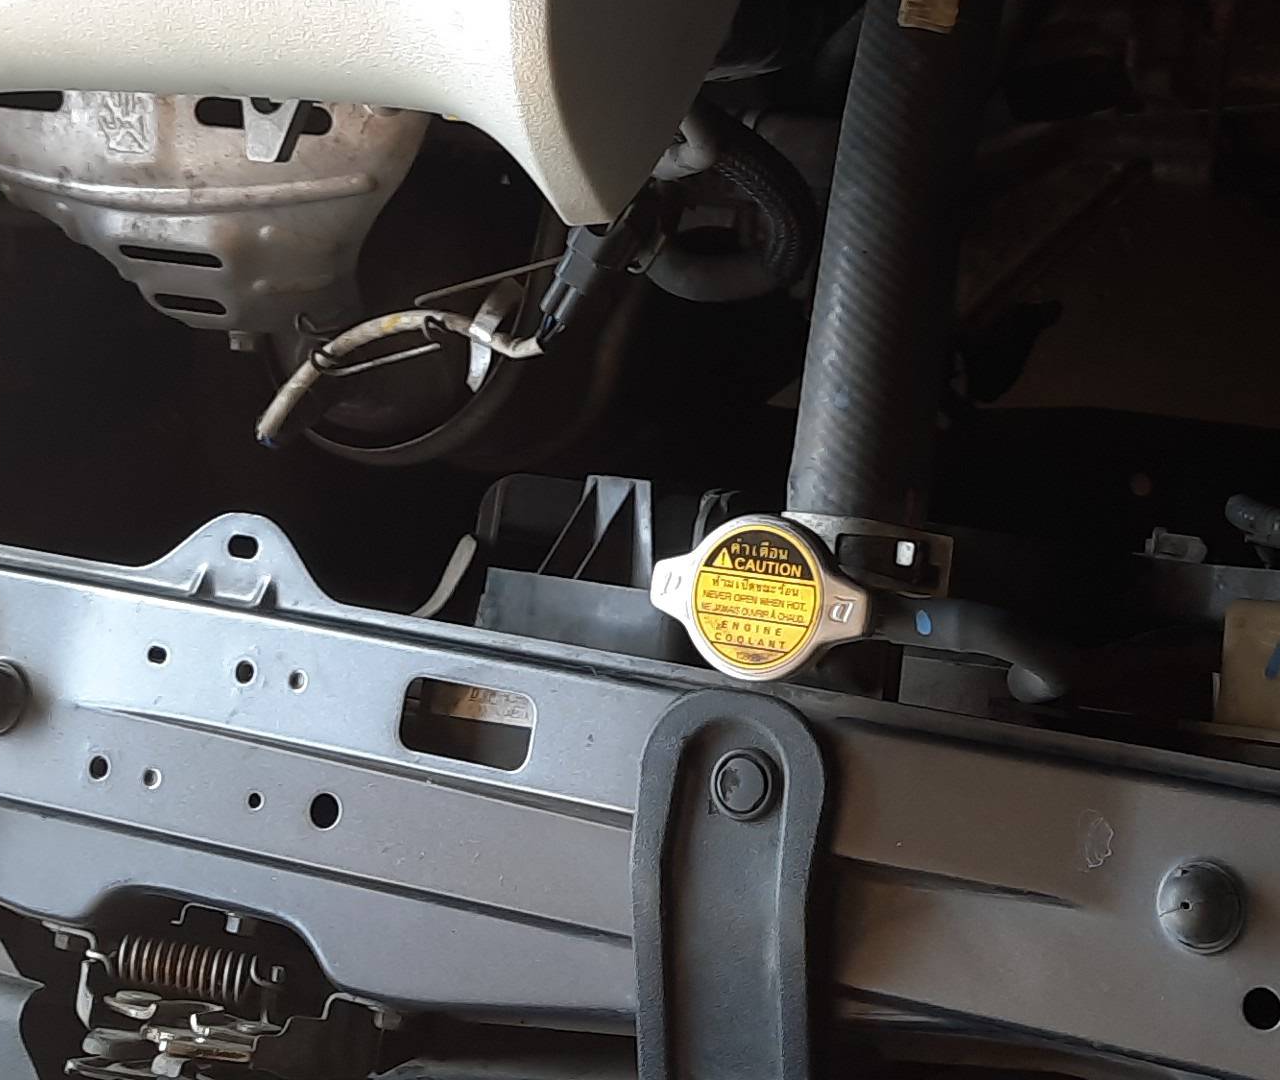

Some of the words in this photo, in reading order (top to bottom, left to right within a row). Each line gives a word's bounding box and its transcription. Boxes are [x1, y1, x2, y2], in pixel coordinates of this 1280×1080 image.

[734, 557, 803, 578] CAUTION
[703, 589, 732, 601] NEVER
[733, 593, 758, 605] OPEN
[759, 596, 785, 608] WHEN
[721, 619, 783, 637] ENGINE
[714, 632, 787, 650] COOLANT
